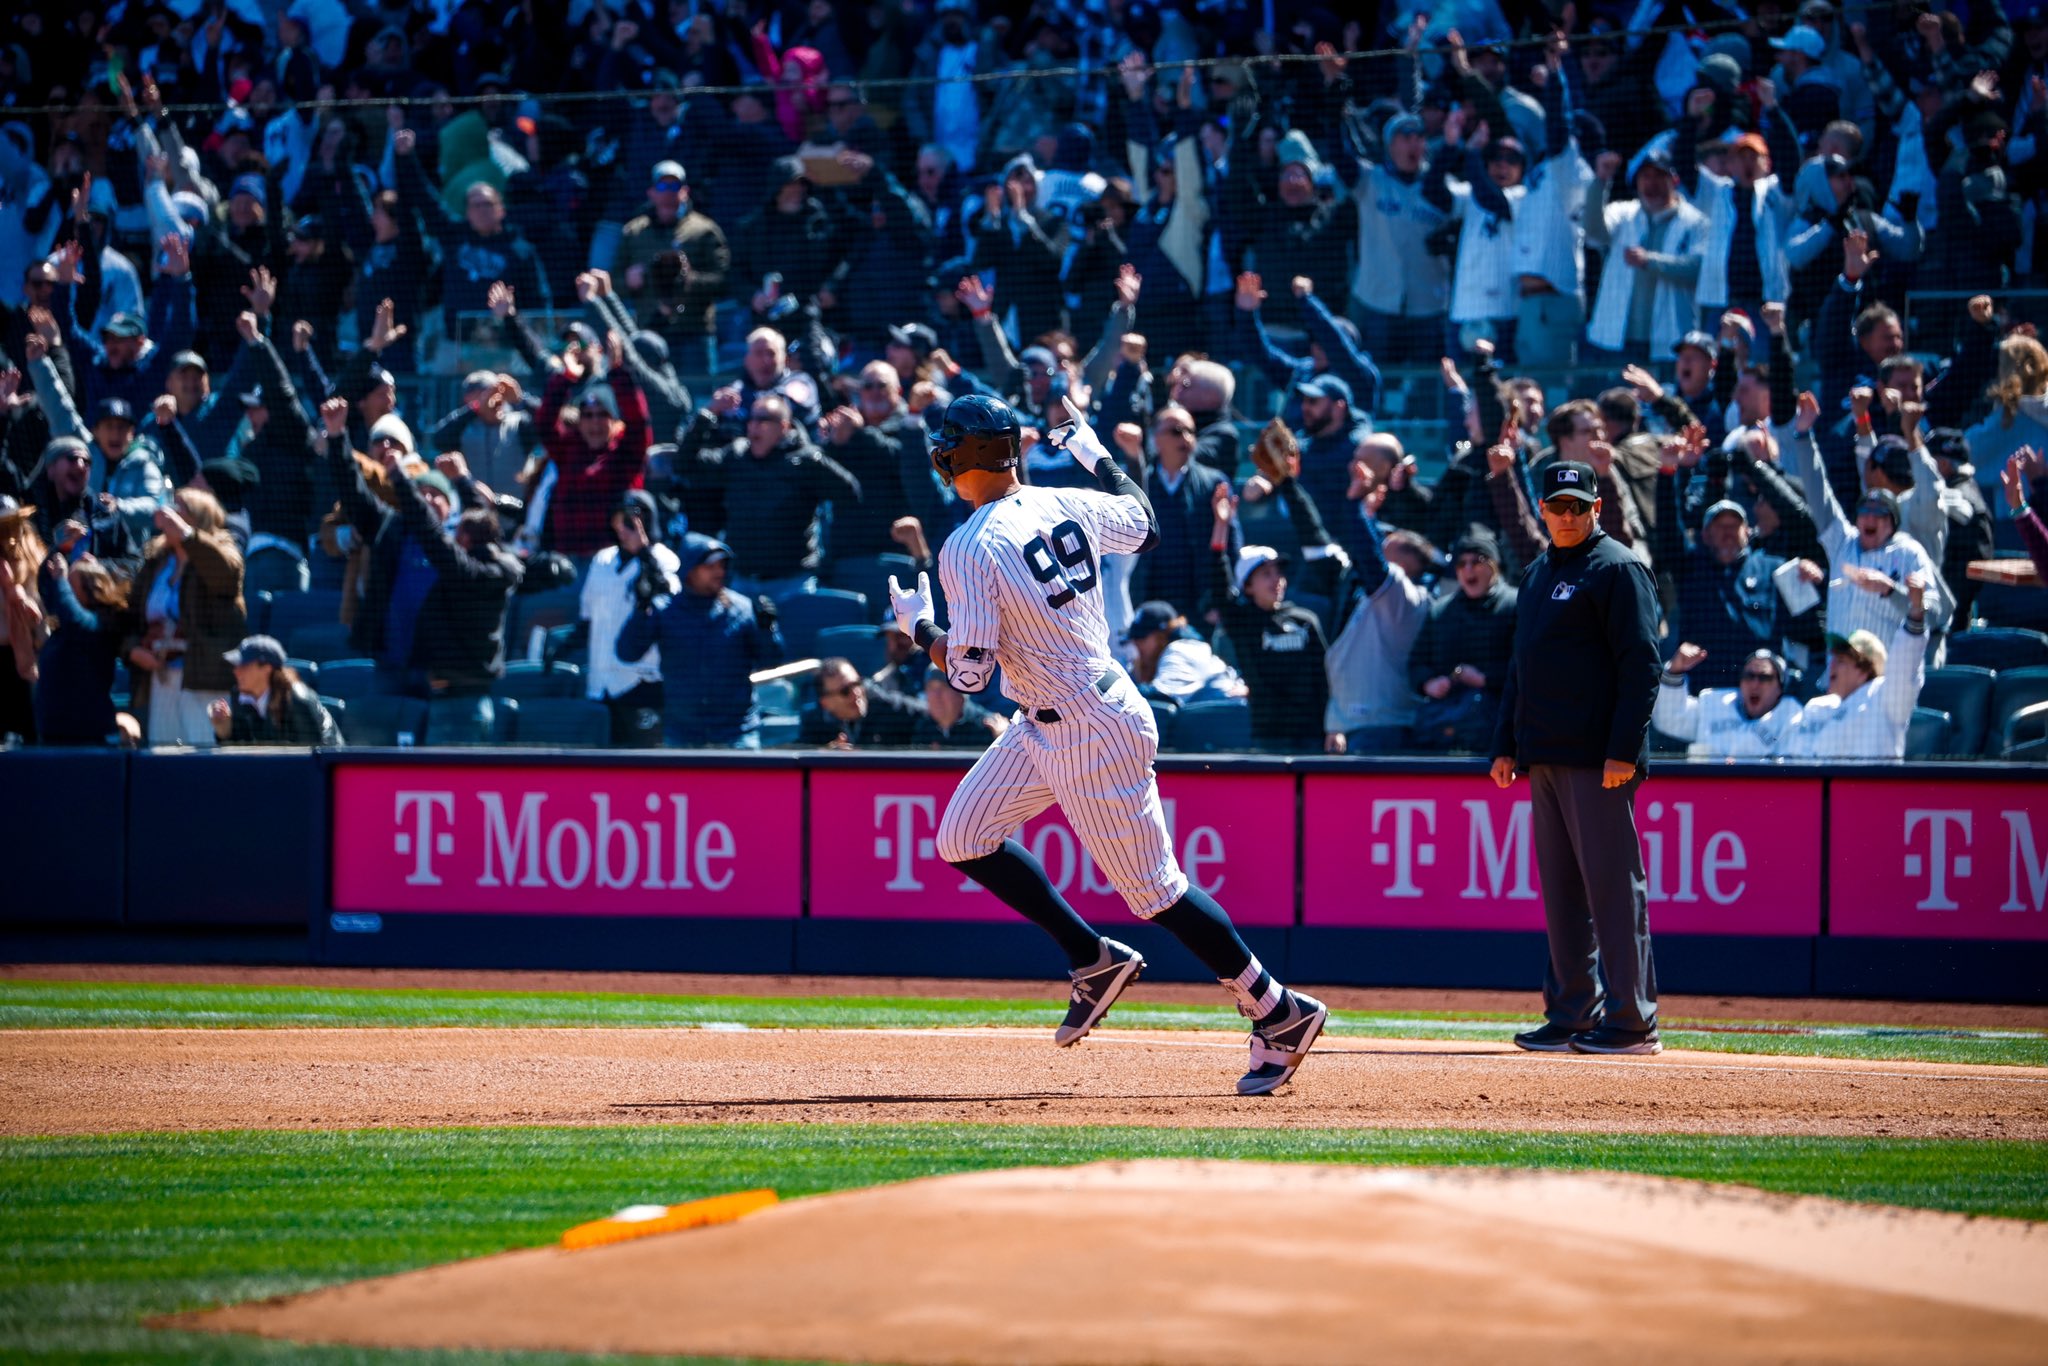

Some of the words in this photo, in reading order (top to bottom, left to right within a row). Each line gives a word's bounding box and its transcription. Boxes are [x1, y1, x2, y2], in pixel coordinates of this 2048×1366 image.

[1023, 519, 1097, 610] 99
[396, 790, 454, 886] T
[476, 792, 736, 890] Mobile
[874, 794, 936, 892] T
[1371, 799, 1436, 898] T
[1459, 800, 1748, 904] Mile
[1904, 808, 1973, 911] T
